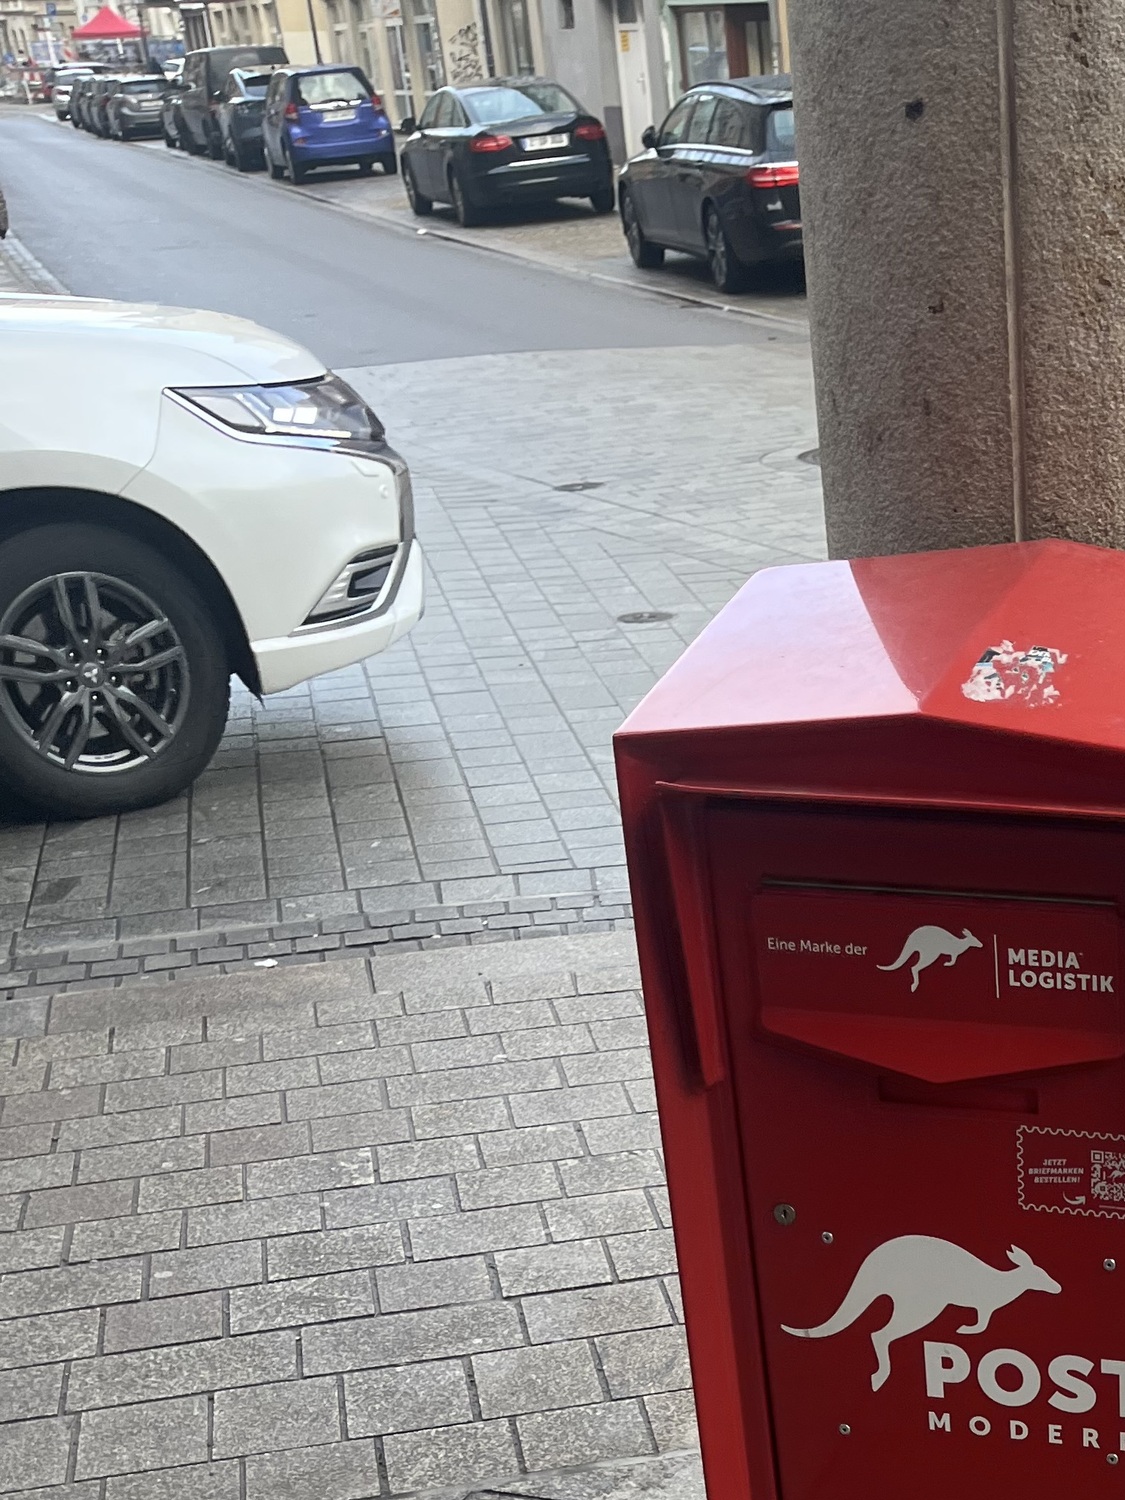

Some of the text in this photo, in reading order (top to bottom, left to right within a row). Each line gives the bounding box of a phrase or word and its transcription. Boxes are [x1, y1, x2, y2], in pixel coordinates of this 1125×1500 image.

[767, 937, 868, 956] Eine Marke der
[1007, 948, 1080, 969] MEDIA
[1008, 969, 1115, 993] LOGISTIK
[1042, 1158, 1067, 1166] JETZT
[1028, 1167, 1084, 1175] BRIEFMARKEN
[1033, 1176, 1081, 1184] BESTELLEN!
